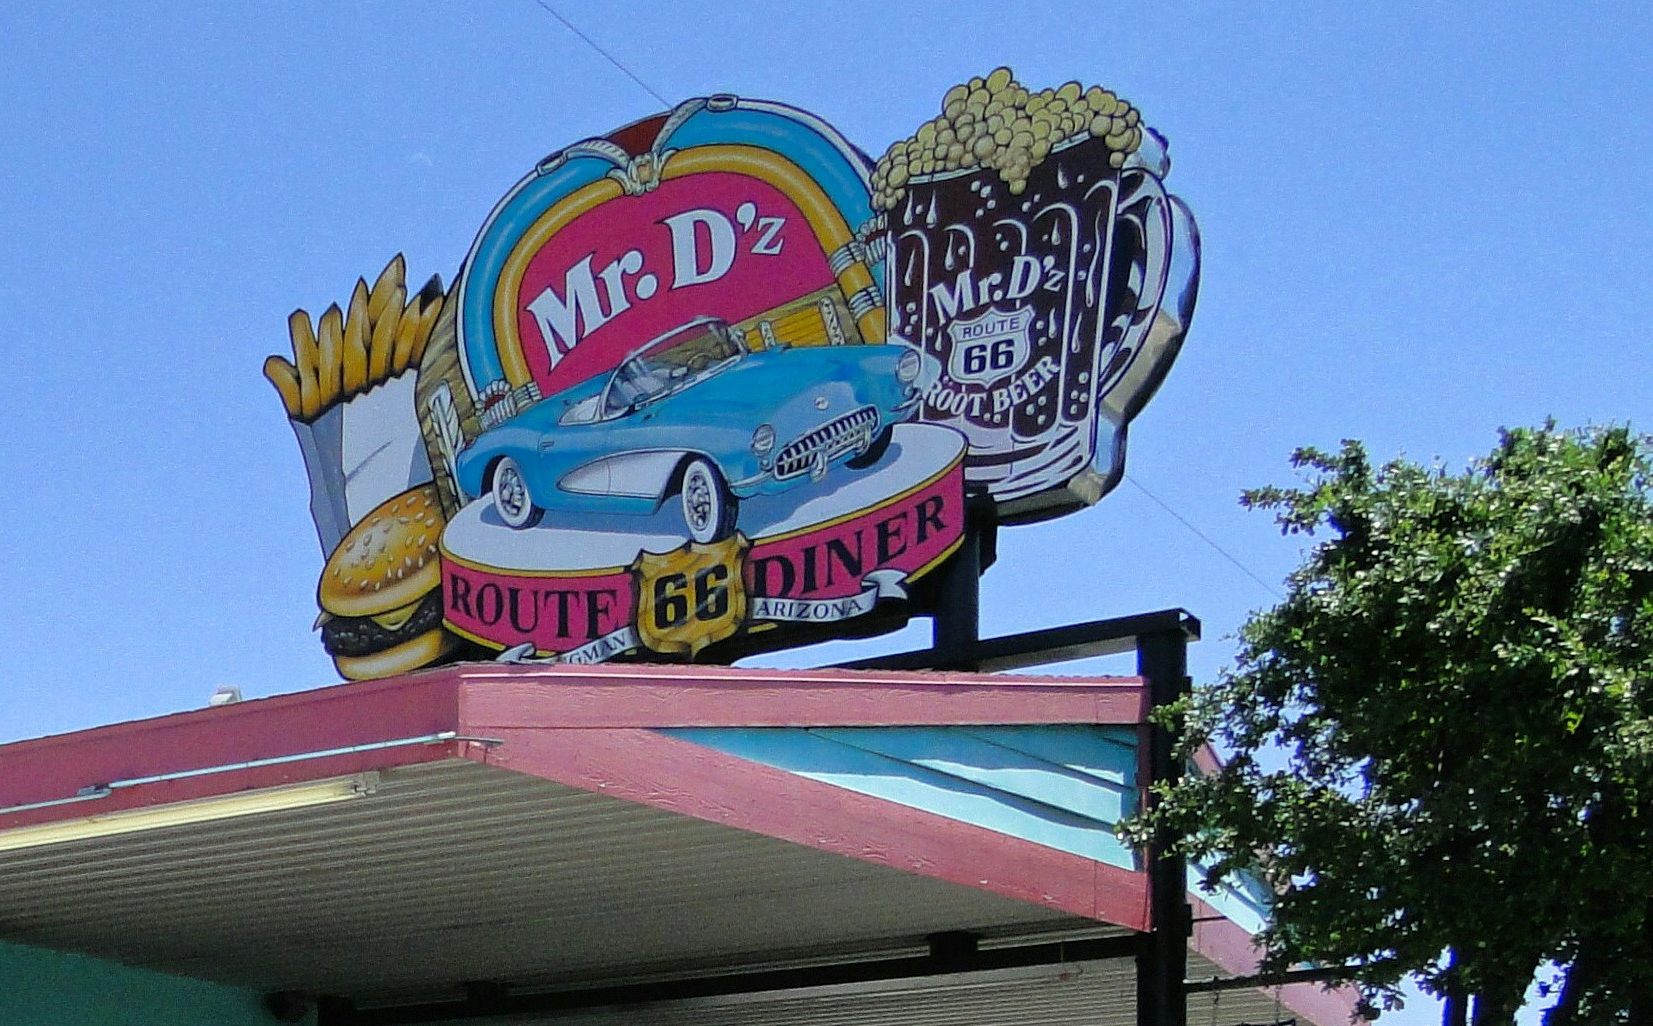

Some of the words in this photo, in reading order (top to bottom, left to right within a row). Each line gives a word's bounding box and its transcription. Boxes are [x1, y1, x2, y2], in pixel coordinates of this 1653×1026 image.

[526, 250, 658, 374] Mr.
[661, 201, 786, 290] D'z
[929, 269, 1003, 326] Mr.
[1006, 255, 1066, 299] D'z
[962, 317, 1020, 339] ROUTE
[963, 339, 1015, 375] 66
[923, 381, 987, 417] ROOT
[993, 356, 1061, 414] BEER
[450, 573, 619, 639] ROUTE
[653, 564, 729, 629] 66
[752, 495, 947, 597] DINER
[561, 632, 626, 664] GMAN
[755, 599, 864, 619] ARIZONA
